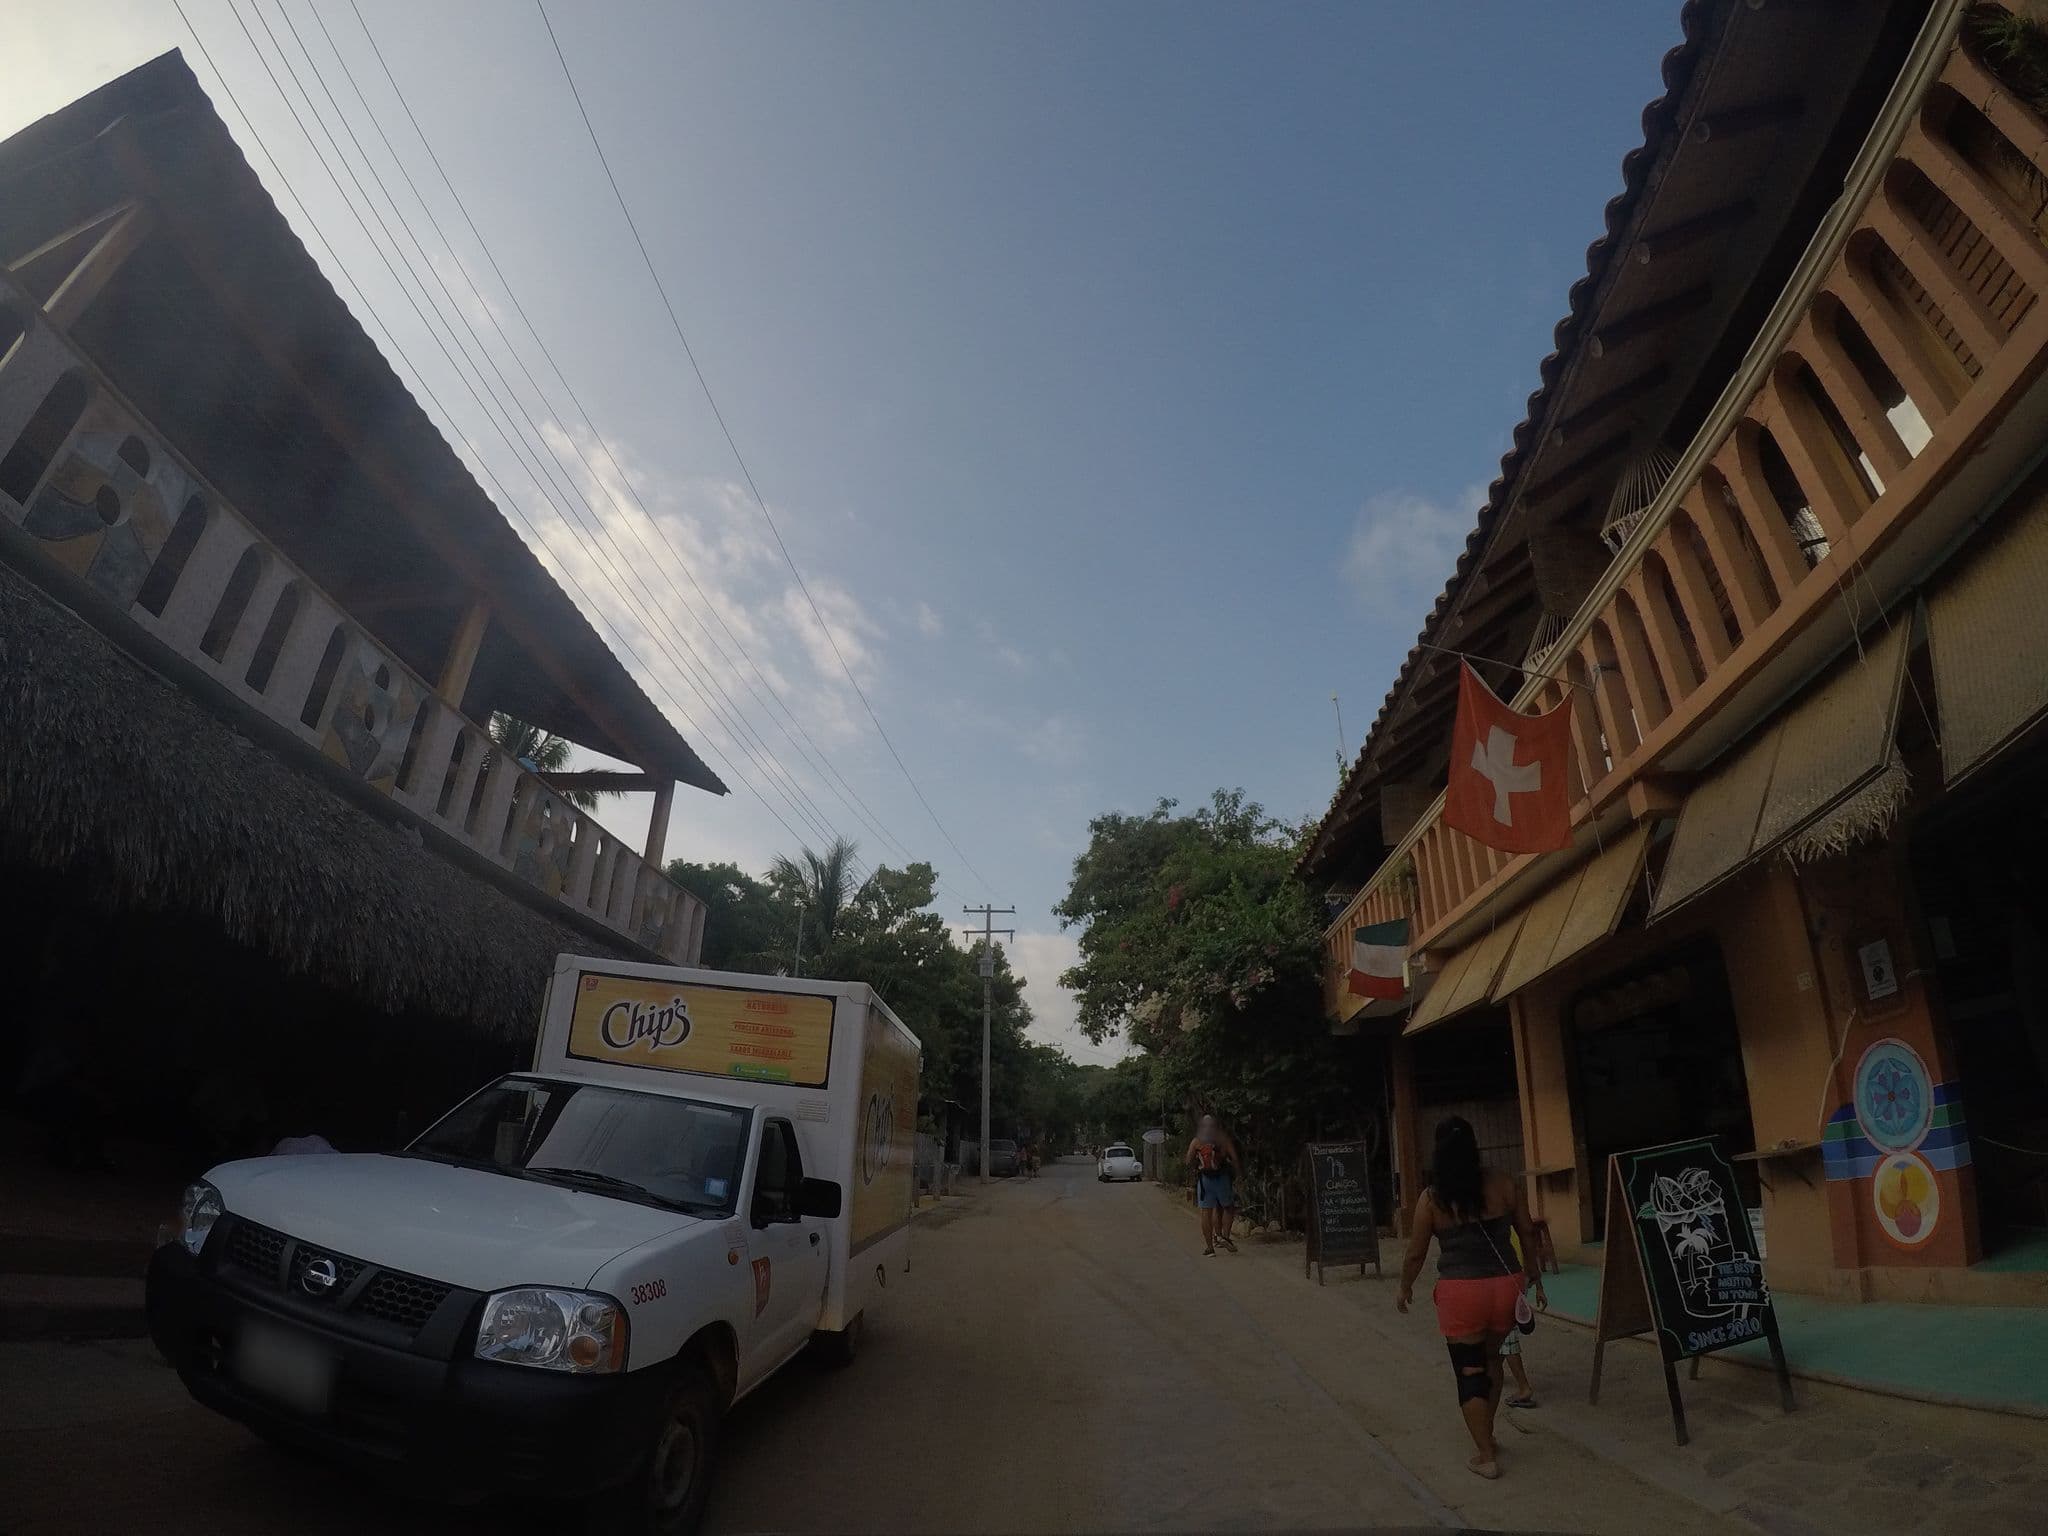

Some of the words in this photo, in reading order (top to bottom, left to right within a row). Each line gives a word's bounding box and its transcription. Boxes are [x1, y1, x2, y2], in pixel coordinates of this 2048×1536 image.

[601, 998, 691, 1049] Chip's
[1734, 1263, 1756, 1274] BEST
[631, 1279, 667, 1306] 38308
[1718, 1290, 1729, 1300] IN
[1730, 1289, 1758, 1300] TOWN
[1688, 1325, 1727, 1351] SINCE
[1727, 1317, 1761, 1341] 2010
